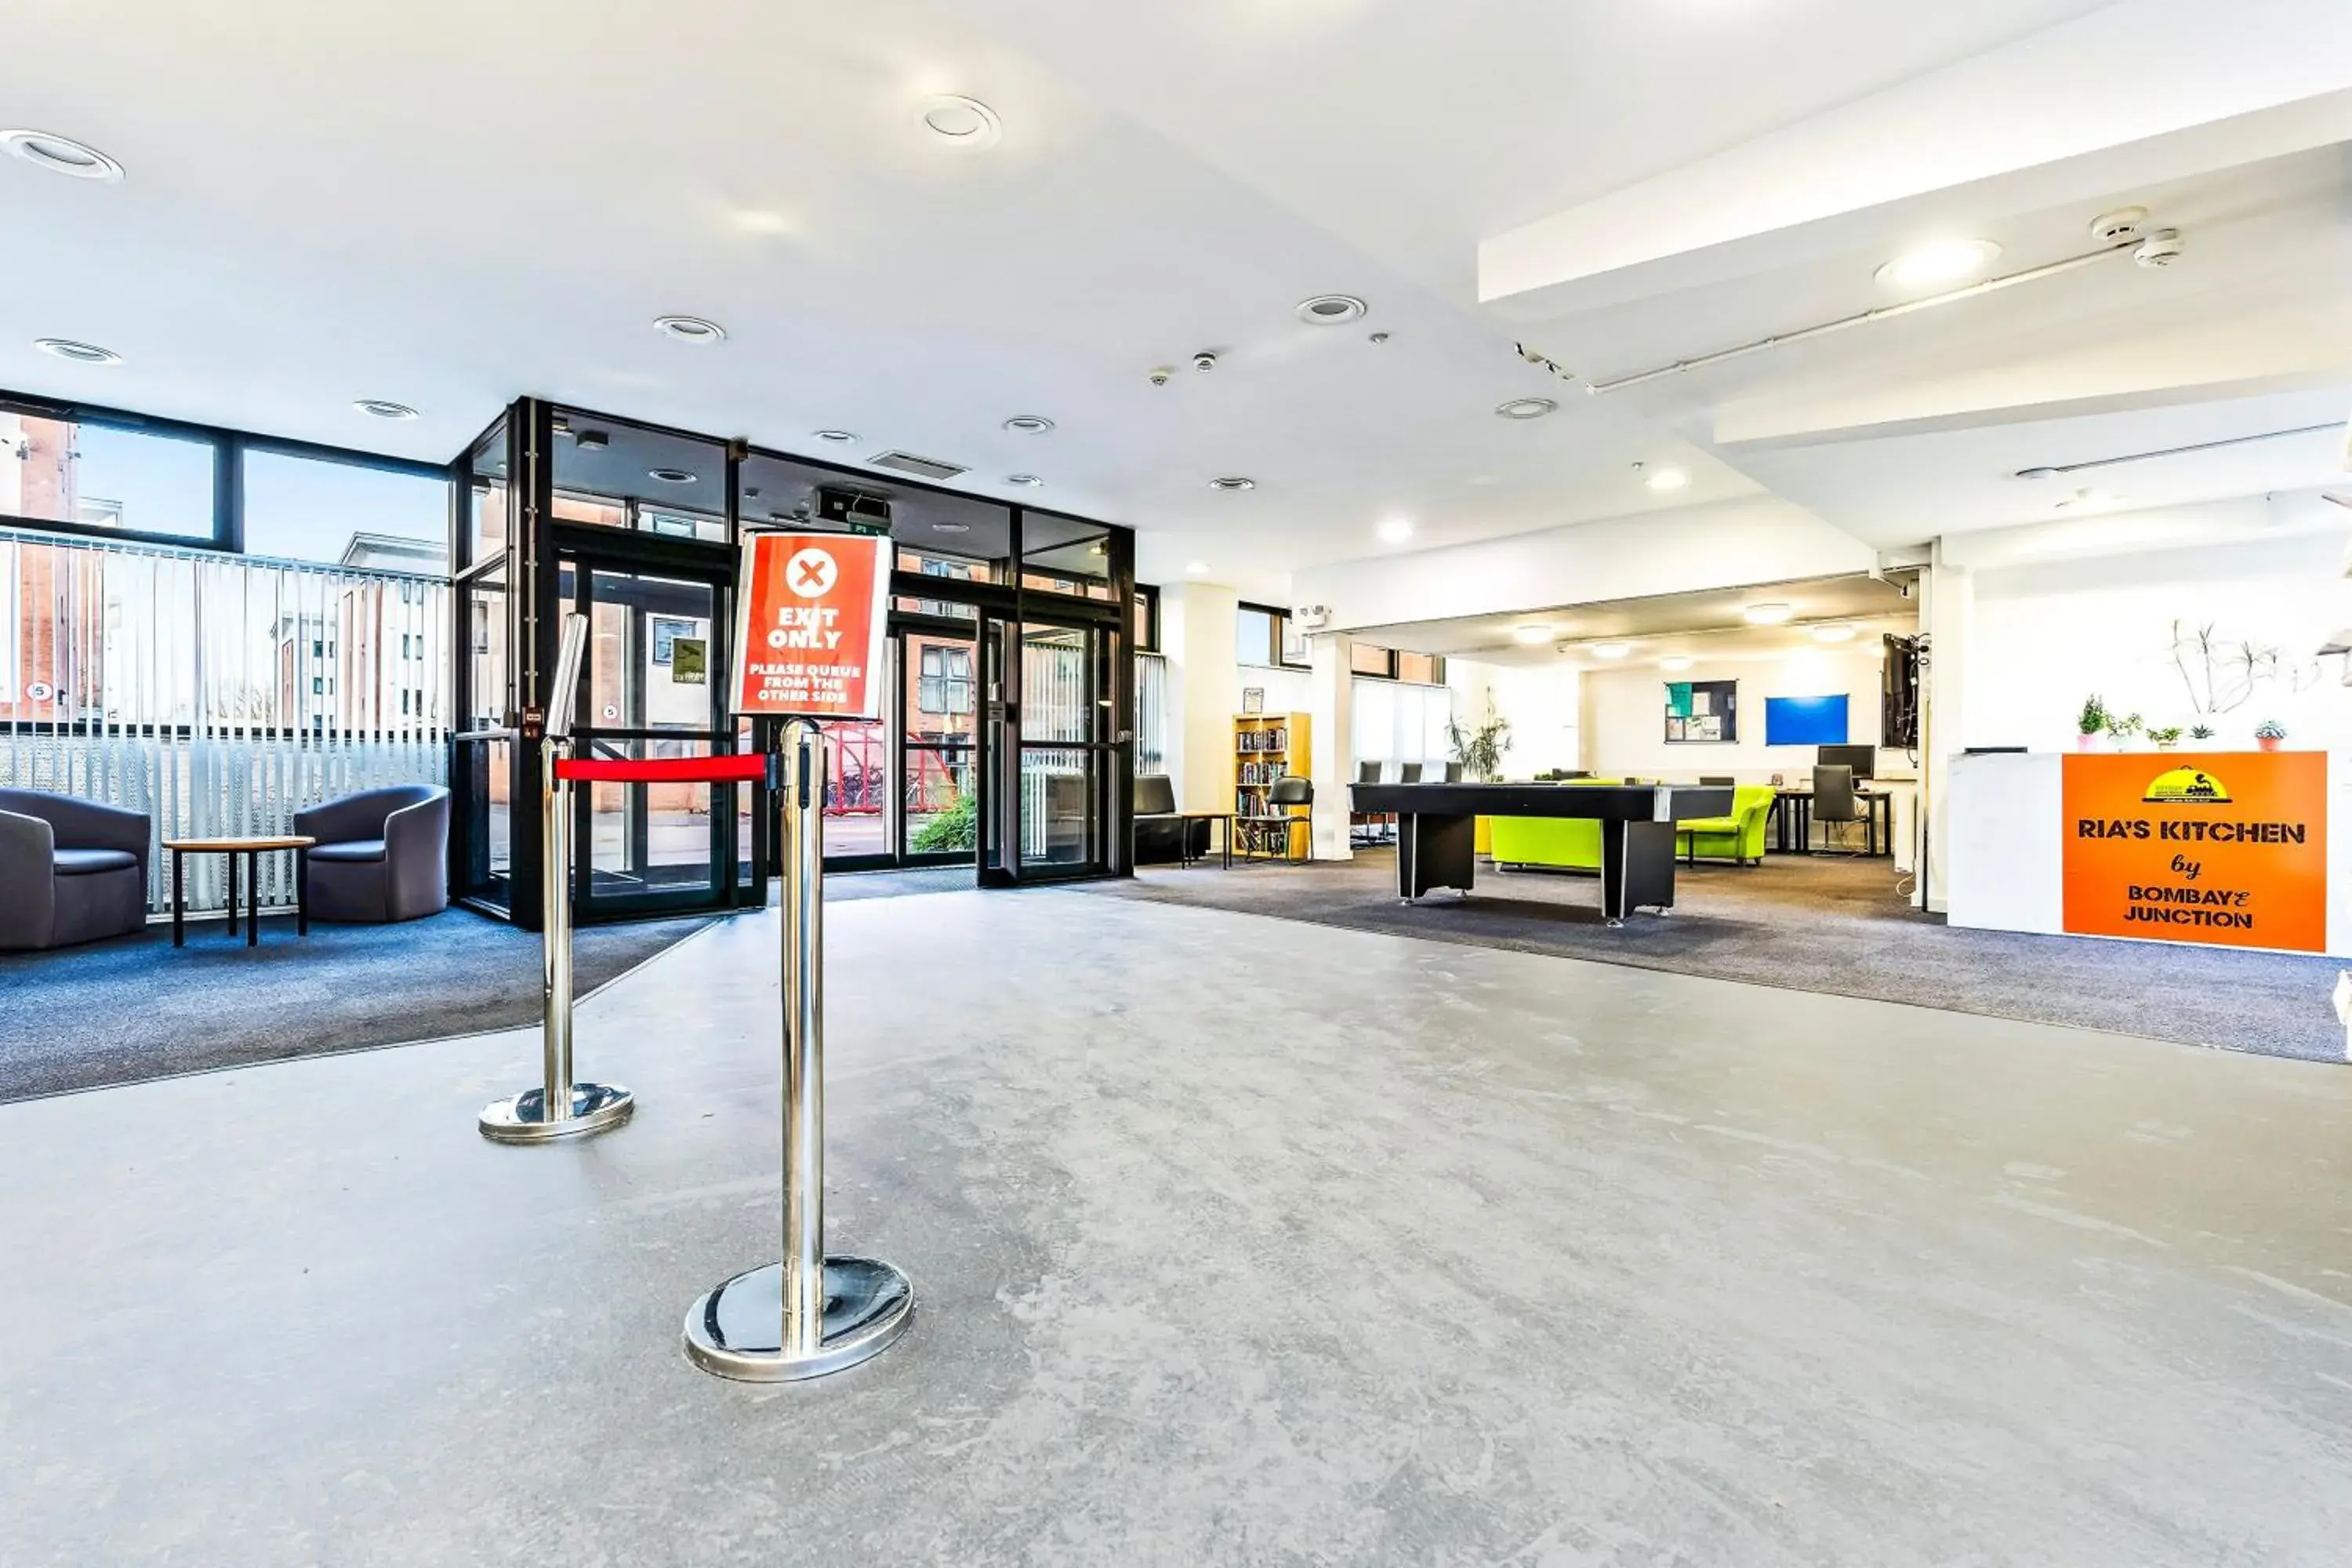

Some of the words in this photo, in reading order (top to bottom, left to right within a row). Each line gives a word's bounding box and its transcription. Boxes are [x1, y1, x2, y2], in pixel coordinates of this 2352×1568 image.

[779, 605, 840, 627] EXIT
[768, 629, 844, 650] ONLY
[750, 664, 804, 675] PLEASE
[807, 665, 862, 678] QUEUE
[764, 677, 809, 688] FROM
[812, 677, 844, 691] THE
[757, 689, 809, 702] OTHER
[811, 691, 848, 704] SIDE
[2078, 819, 2151, 840] RIA'S
[2160, 821, 2305, 844] KITCHEN
[2170, 854, 2201, 880] by
[2123, 906, 2252, 929] JUNCTION
